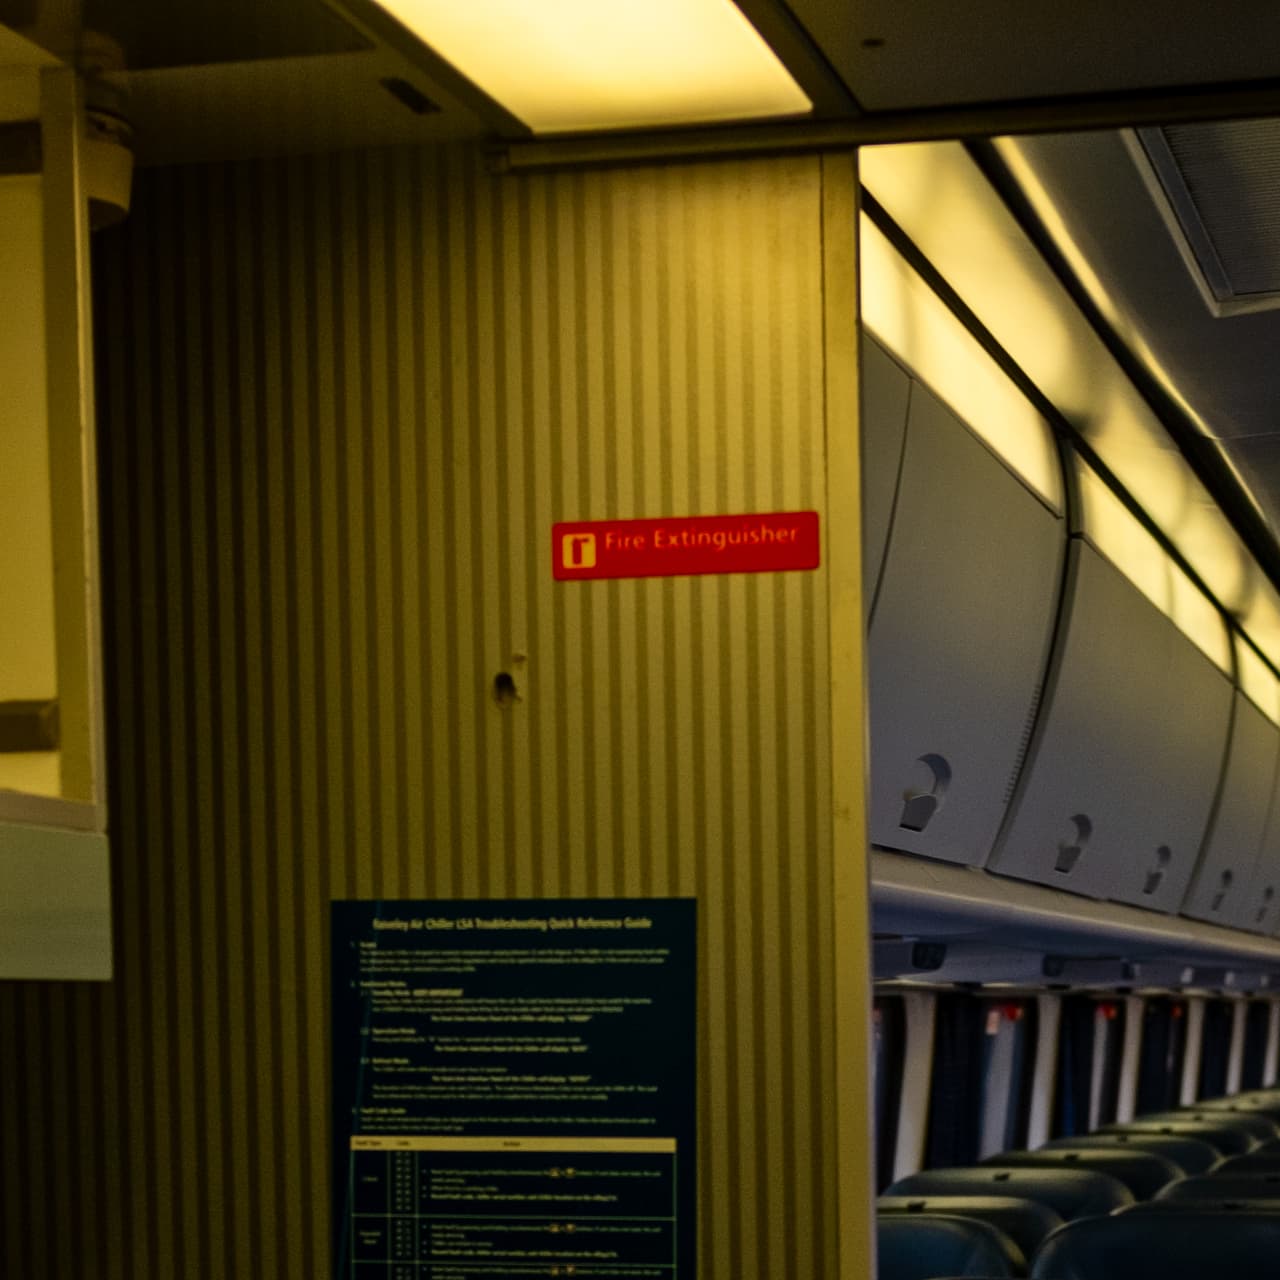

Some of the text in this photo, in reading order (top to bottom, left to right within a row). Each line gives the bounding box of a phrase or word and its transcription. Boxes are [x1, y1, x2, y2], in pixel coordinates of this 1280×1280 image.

[604, 523, 798, 551] Fire Extinguisher
[410, 917, 424, 930] Air
[425, 917, 455, 930] Chiller
[474, 917, 548, 932] Troubleshooting
[548, 916, 575, 930] Quick
[575, 917, 623, 929] Reference
[623, 916, 653, 929] Guide
